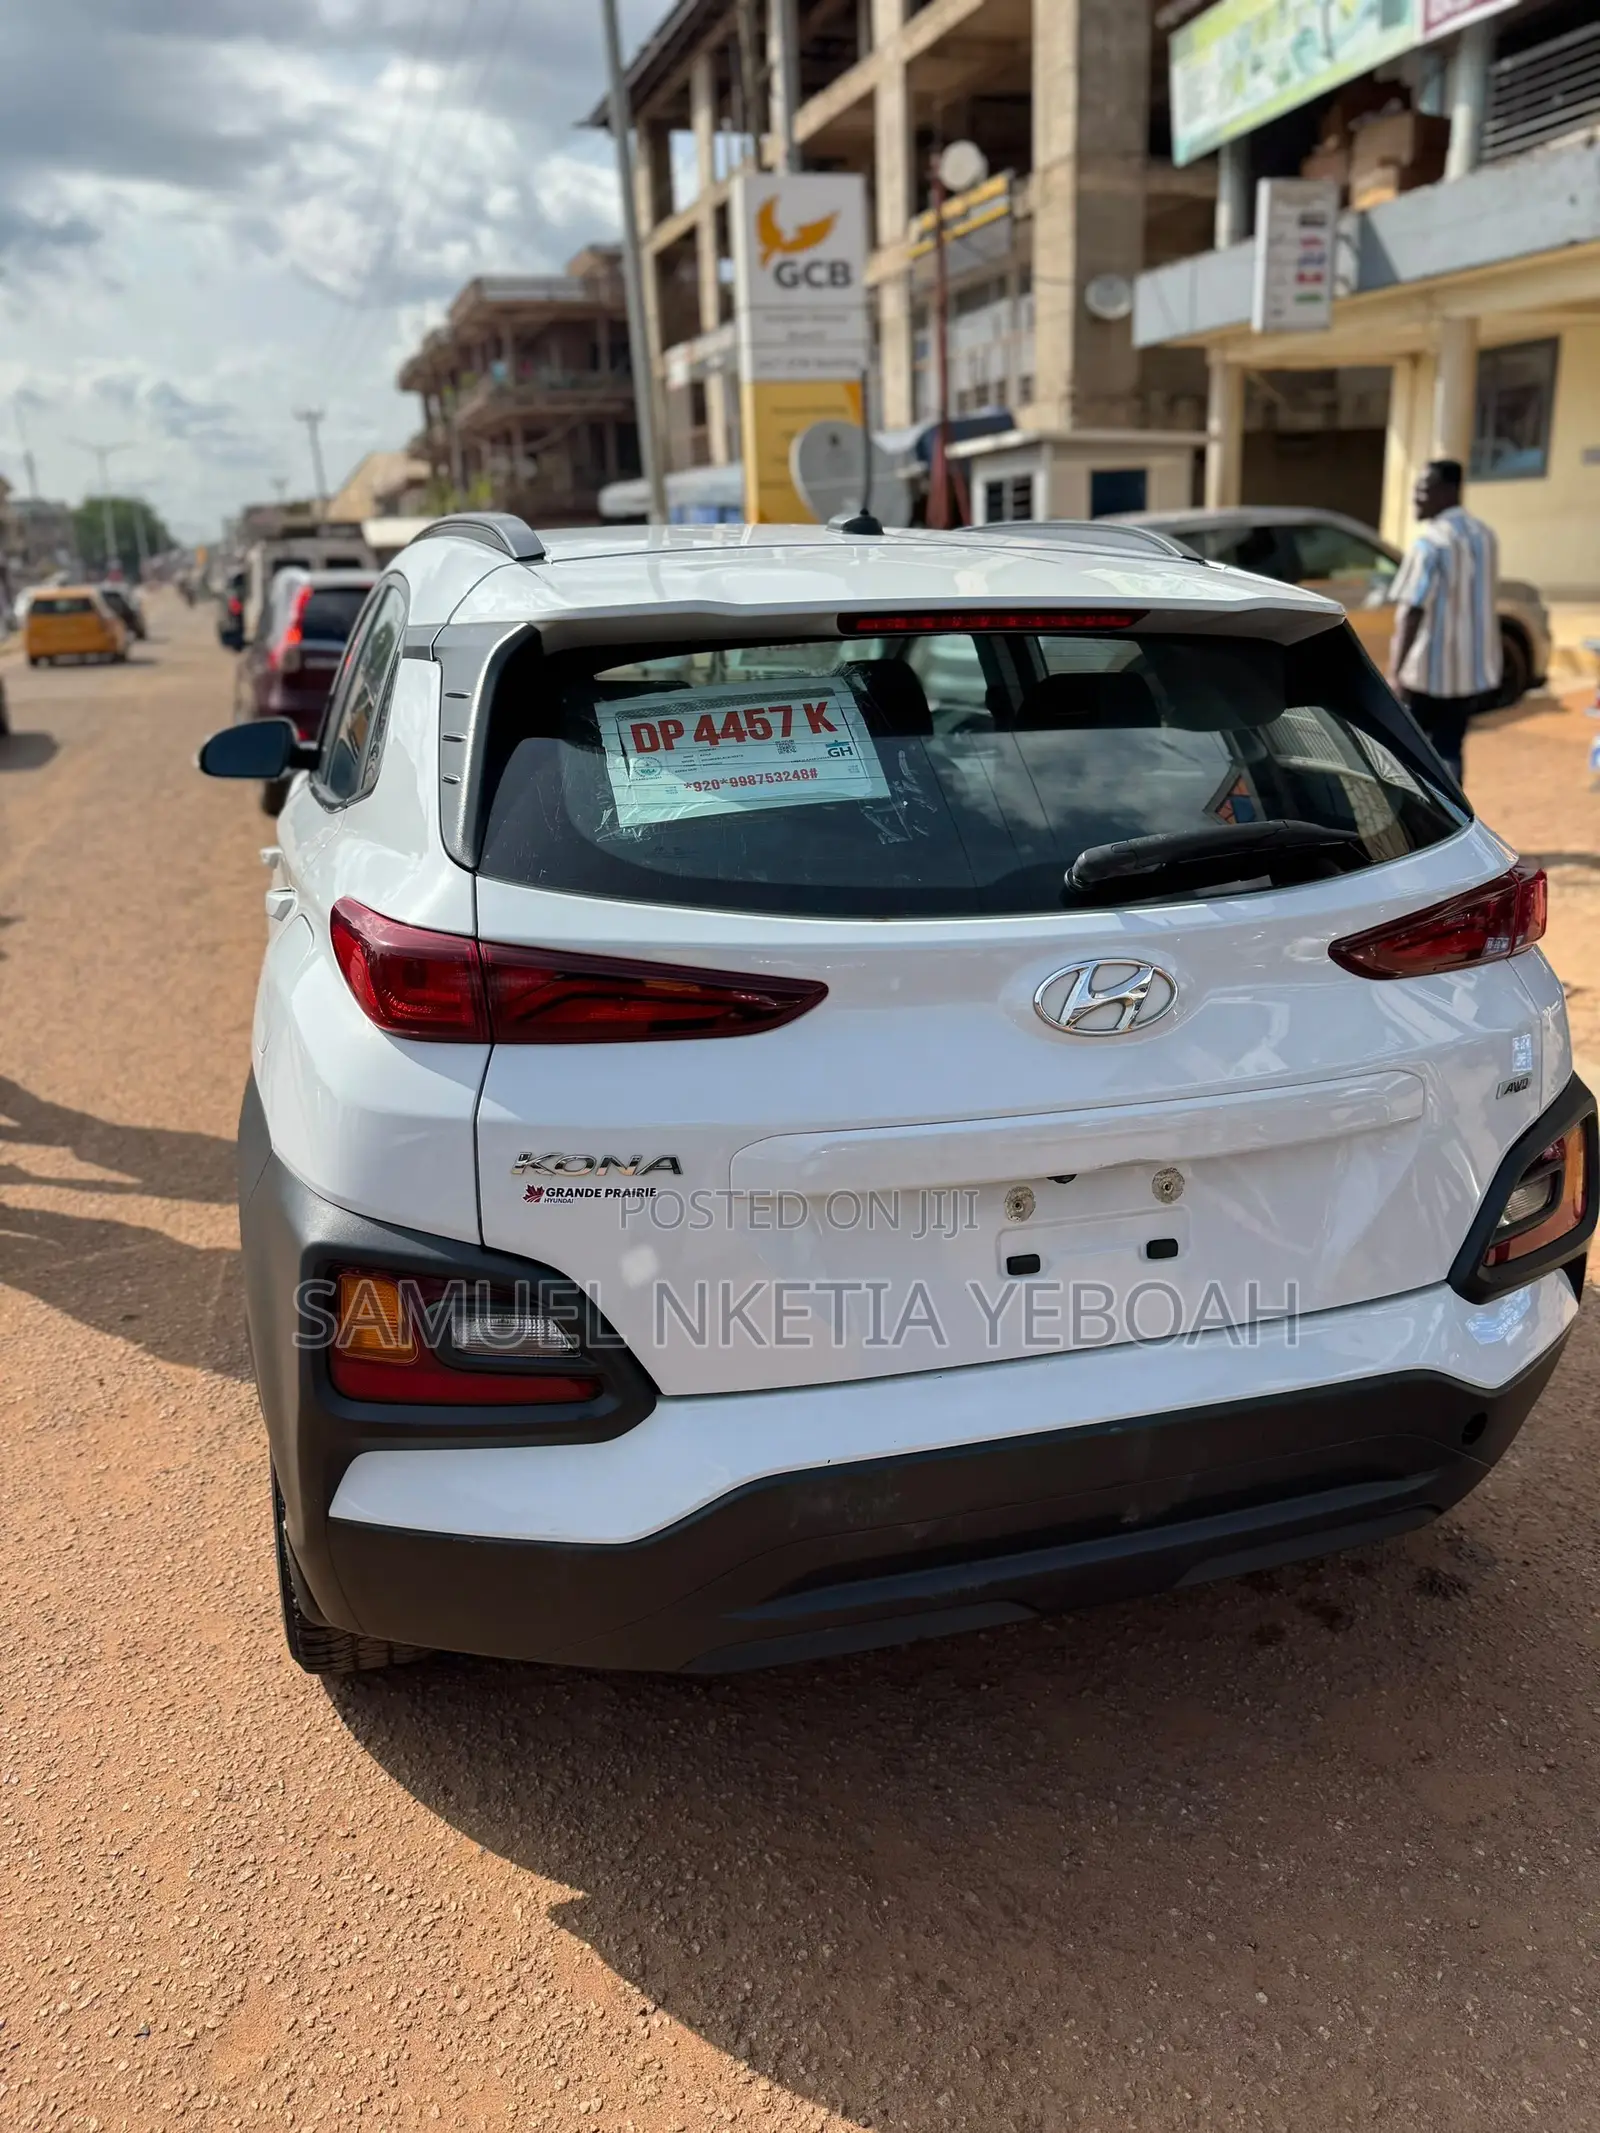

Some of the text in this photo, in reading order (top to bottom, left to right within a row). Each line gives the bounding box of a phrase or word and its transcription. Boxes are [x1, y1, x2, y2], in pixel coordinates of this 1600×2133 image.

[773, 260, 852, 289] GCB
[630, 702, 838, 754] DP 4457 K
[828, 746, 853, 758] GH
[1504, 1078, 1529, 1095] AWD
[510, 1151, 684, 1177] KONA
[545, 1187, 657, 1199] GRANDE PRAIRIE
